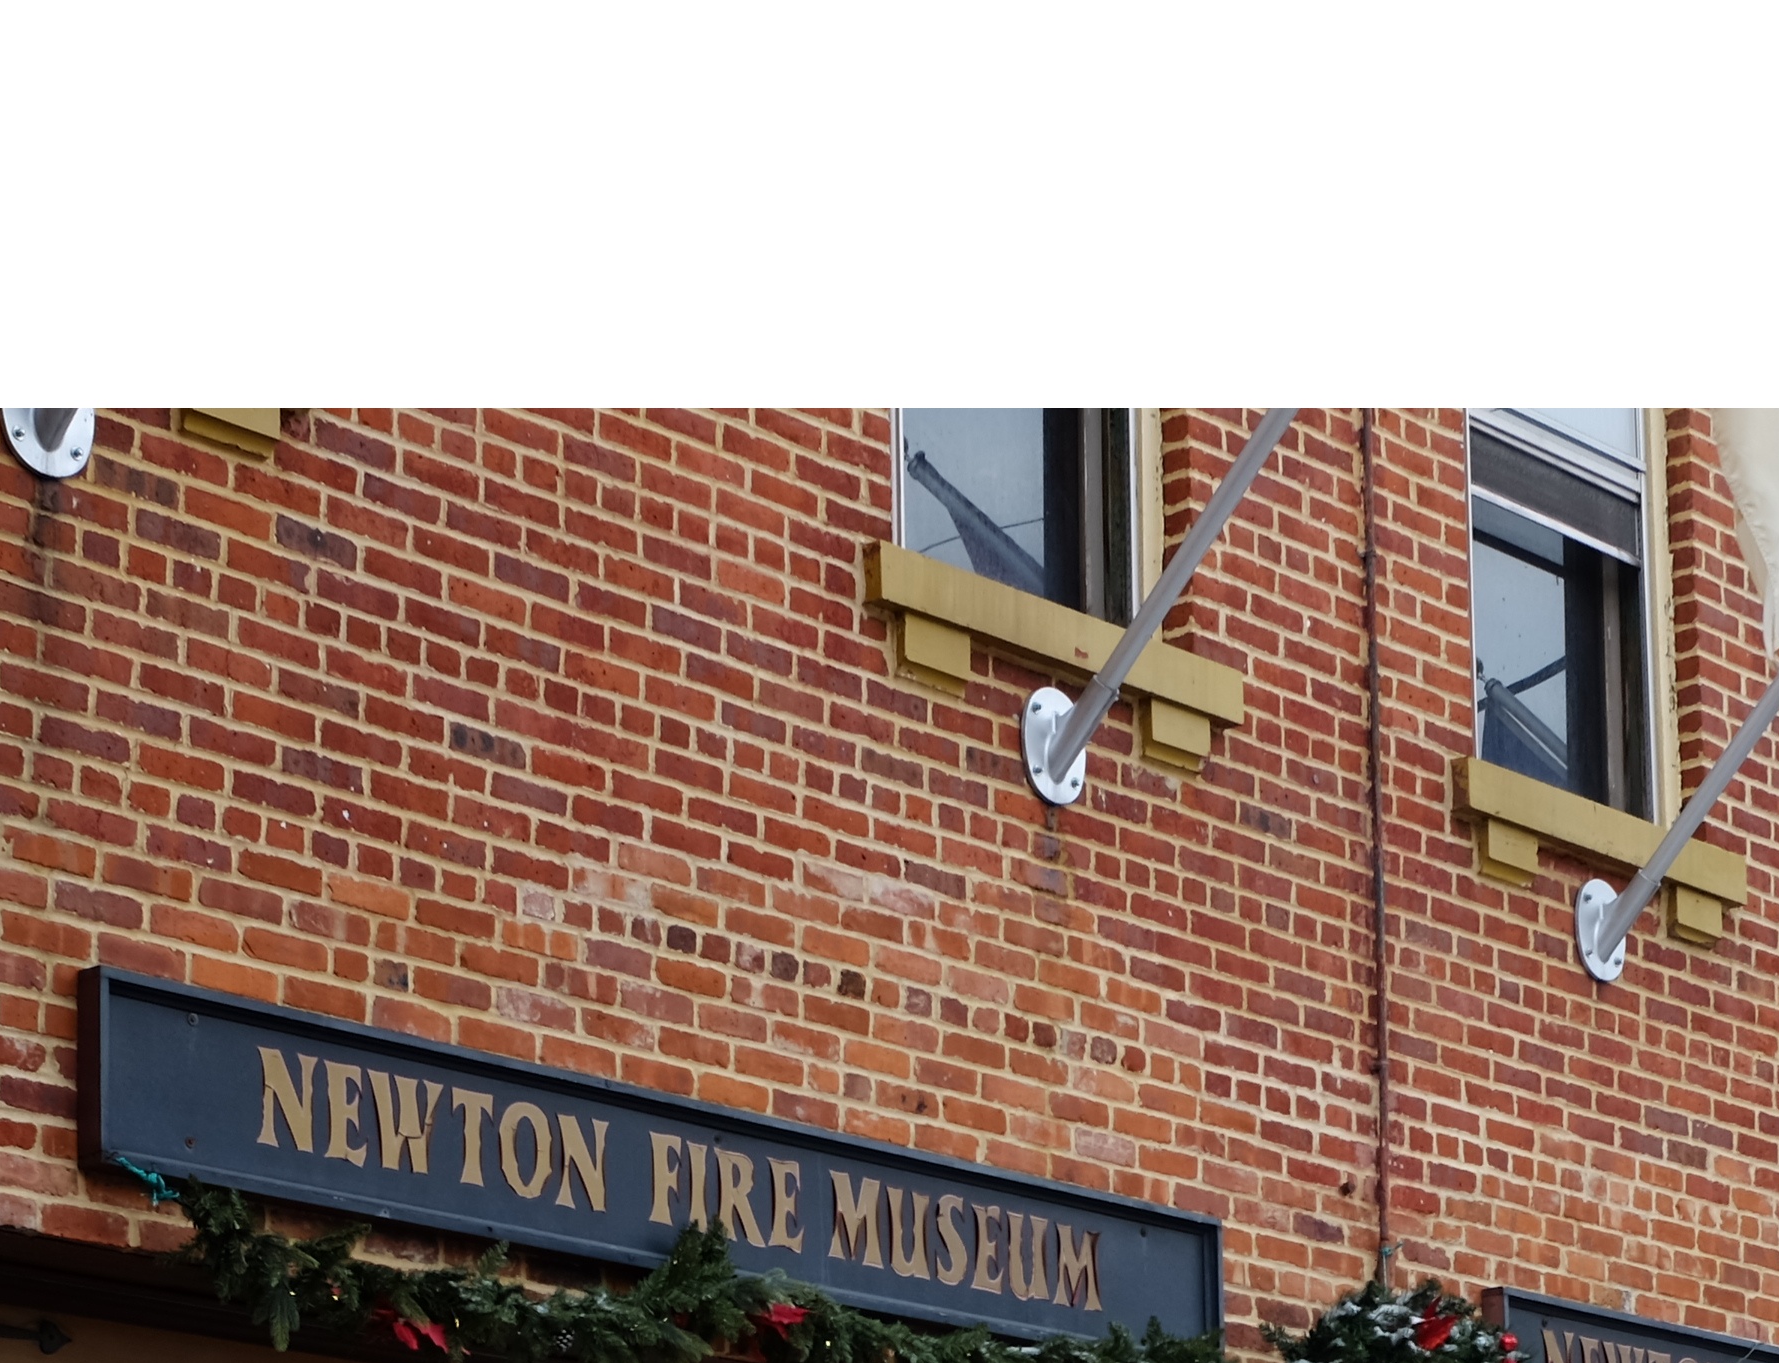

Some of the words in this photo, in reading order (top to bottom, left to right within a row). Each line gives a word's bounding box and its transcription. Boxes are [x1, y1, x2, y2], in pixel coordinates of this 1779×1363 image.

[257, 1045, 610, 1212] NEWTON
[649, 1129, 805, 1254] FIRE
[828, 1169, 1103, 1312] MUSEUM
